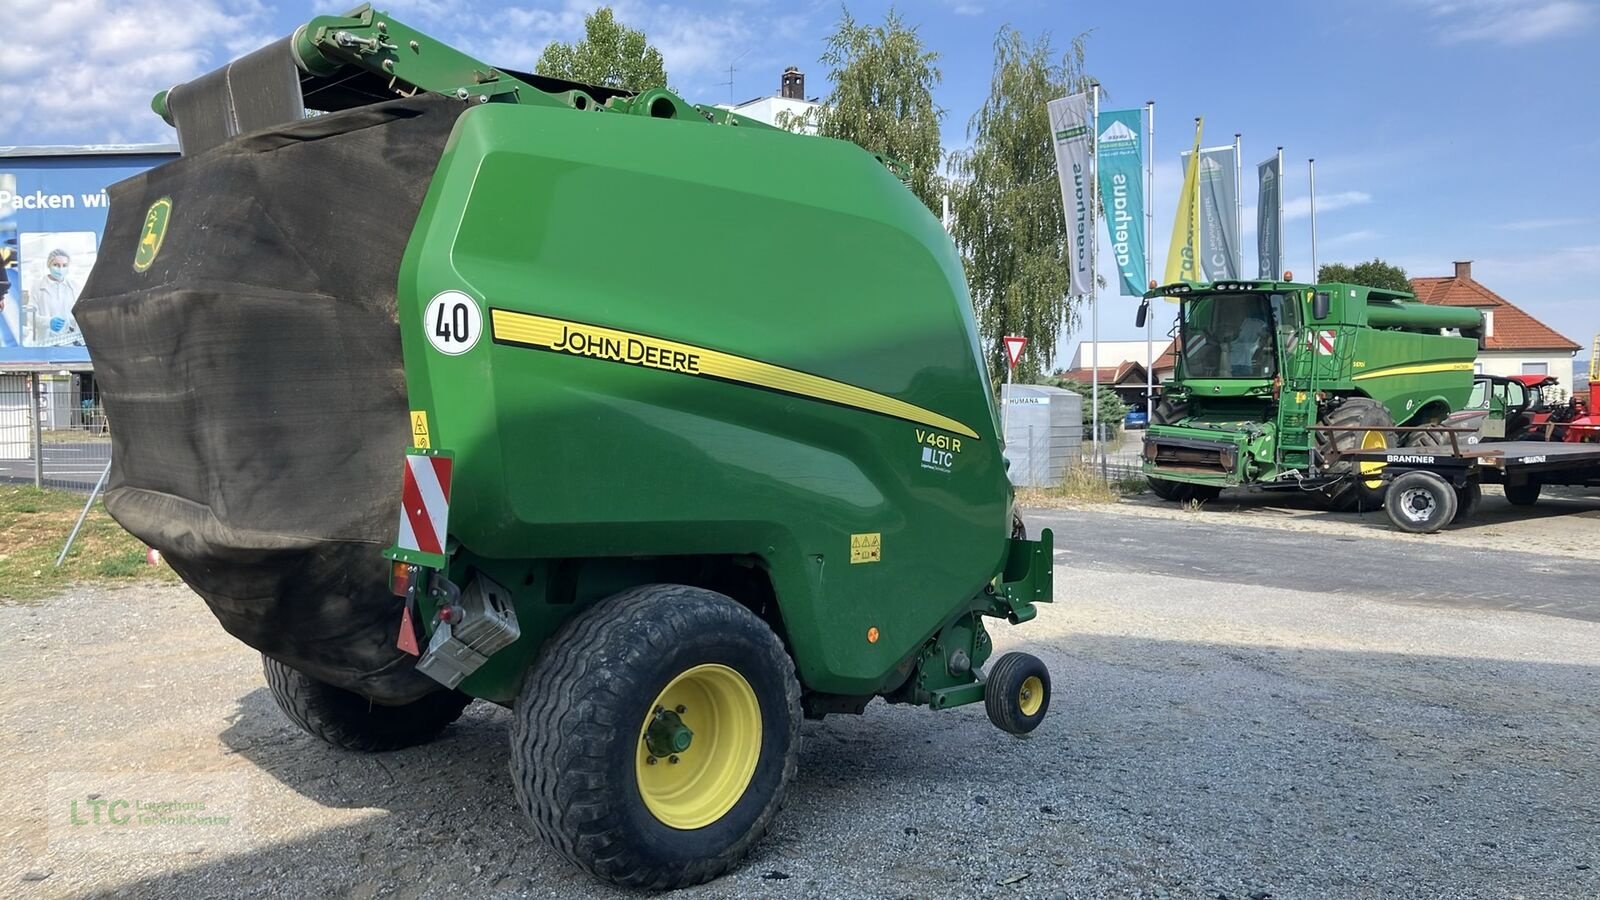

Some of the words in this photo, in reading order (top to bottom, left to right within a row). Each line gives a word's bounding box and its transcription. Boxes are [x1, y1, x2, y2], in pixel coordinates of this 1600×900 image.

[0, 190, 75, 209] Packen
[82, 188, 110, 208] wi
[436, 302, 469, 343] 40
[554, 326, 620, 358] JOHN
[627, 338, 700, 372] DEERE
[915, 429, 926, 444] V
[926, 432, 949, 450] 461
[952, 438, 962, 453] R
[932, 449, 953, 468] LTC
[1386, 454, 1435, 464] BRANTNER
